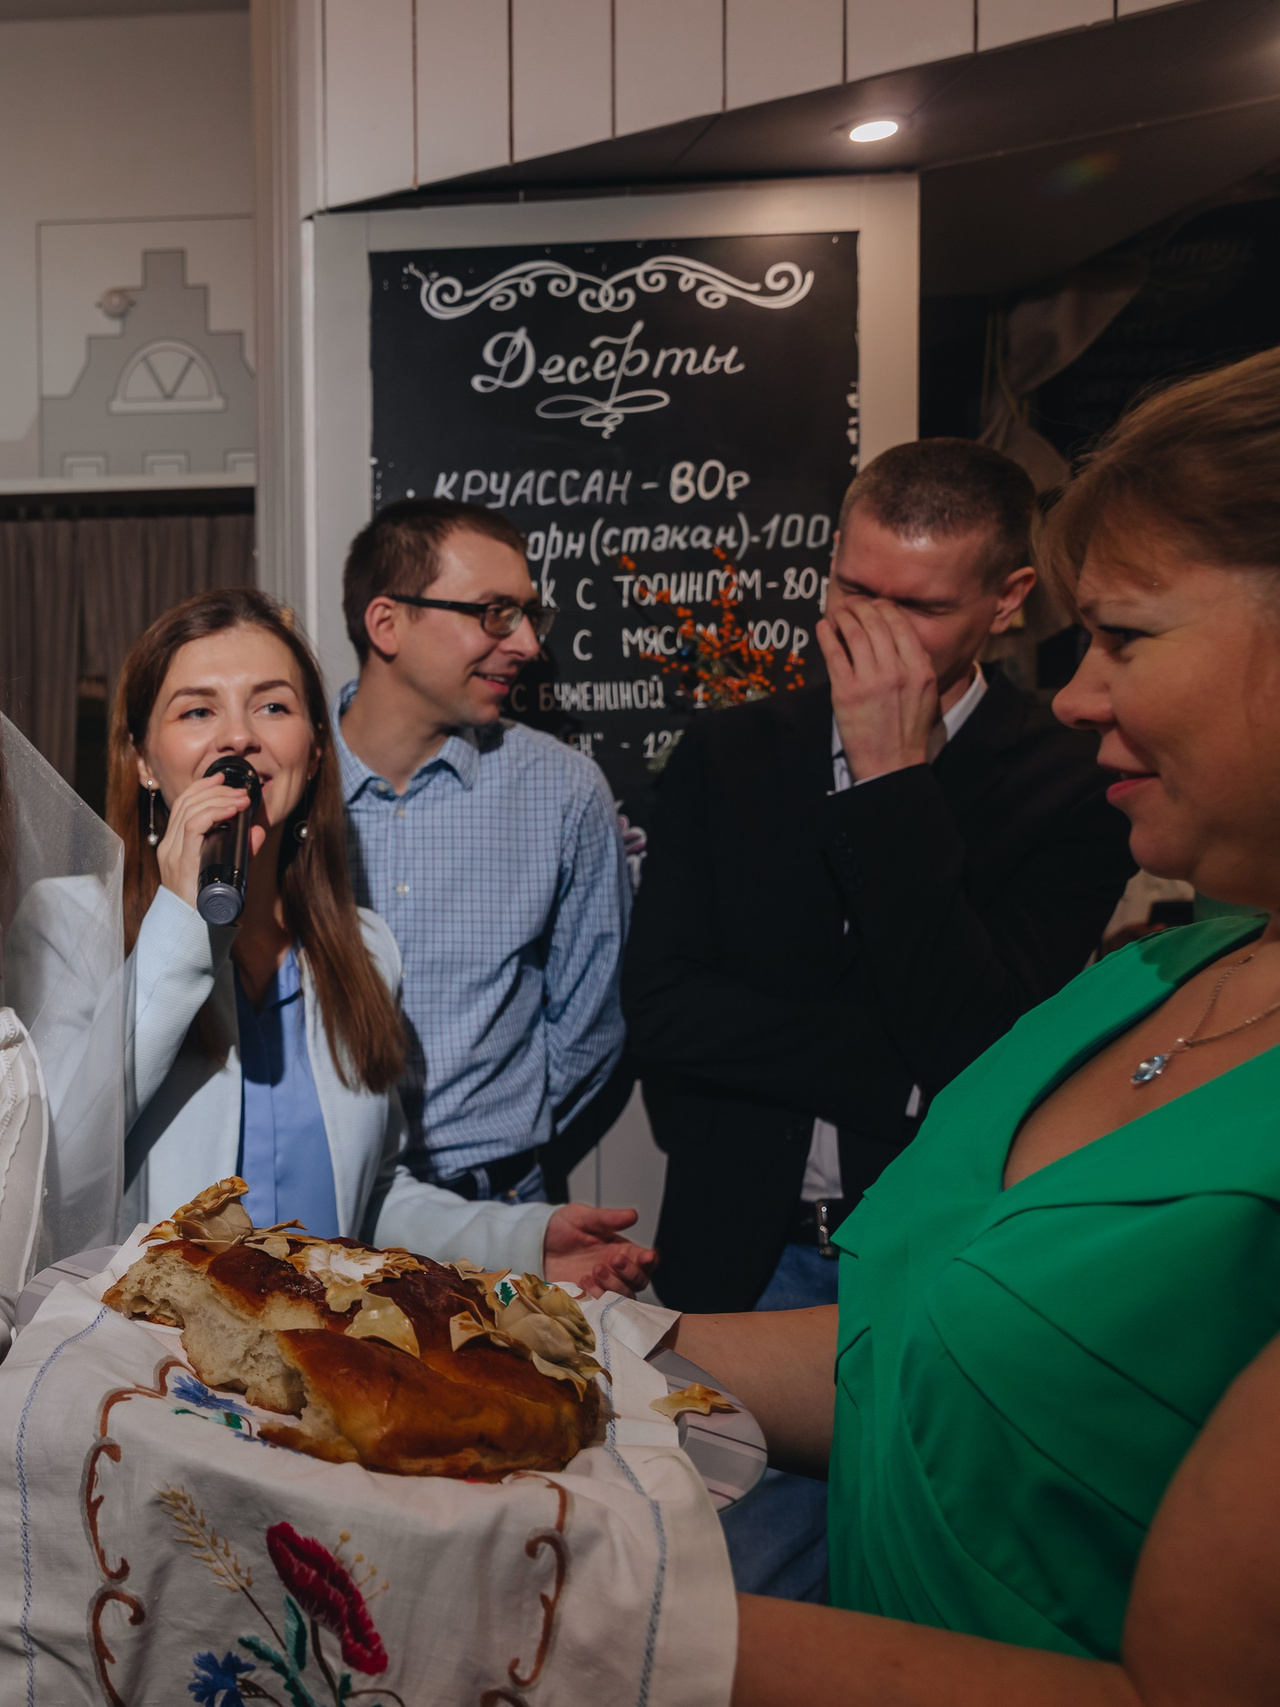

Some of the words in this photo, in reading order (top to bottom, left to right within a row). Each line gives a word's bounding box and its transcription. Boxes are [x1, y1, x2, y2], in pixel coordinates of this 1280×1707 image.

[471, 320, 745, 411] Десерты
[434, 469, 632, 508] КРУАССАН
[576, 577, 597, 611] С
[573, 629, 593, 661] С
